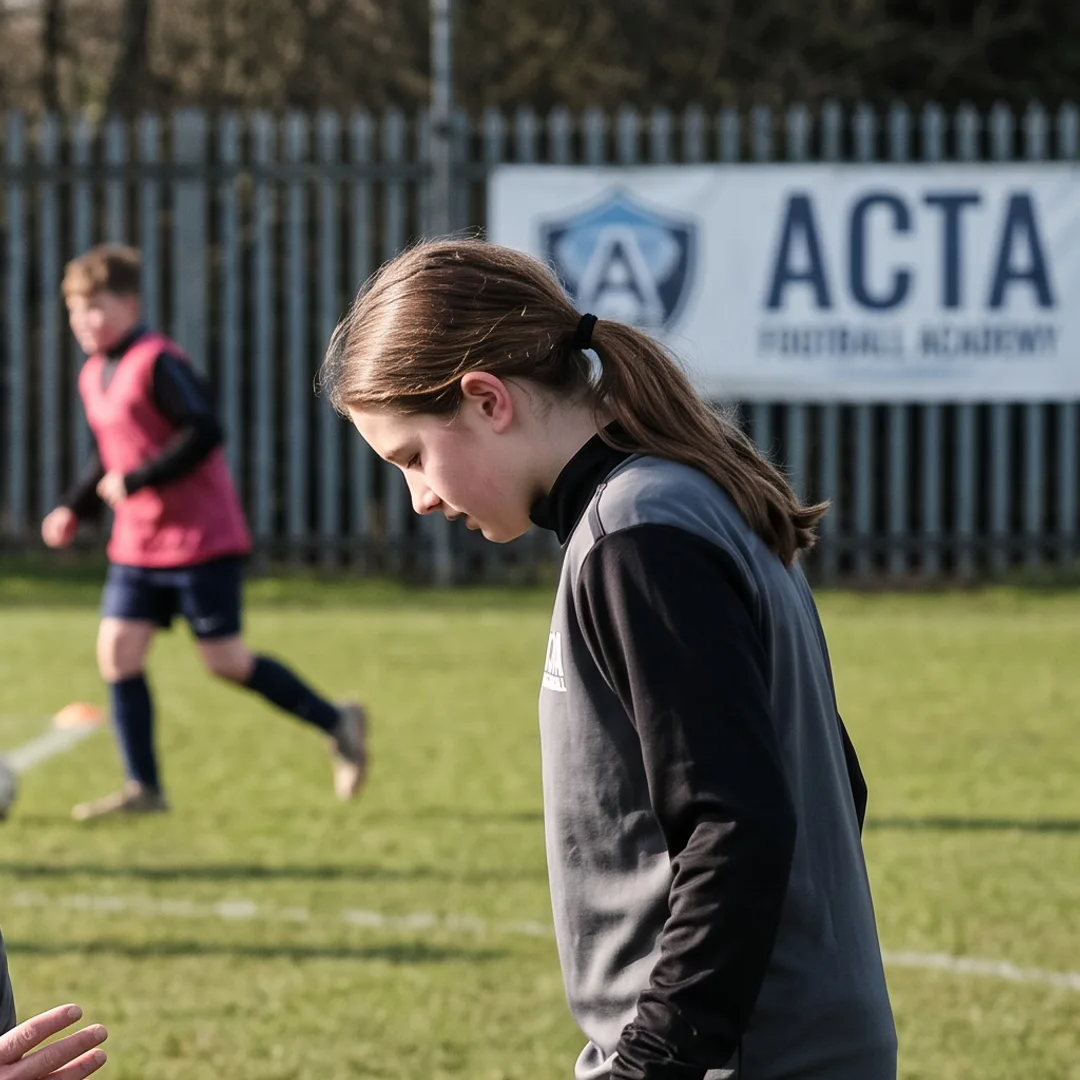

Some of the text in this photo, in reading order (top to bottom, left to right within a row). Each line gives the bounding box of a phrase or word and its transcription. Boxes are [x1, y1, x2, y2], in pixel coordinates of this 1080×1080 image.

[766, 189, 1055, 311] ACTA
[758, 325, 1058, 358] FOOTBALL ACADEMY
